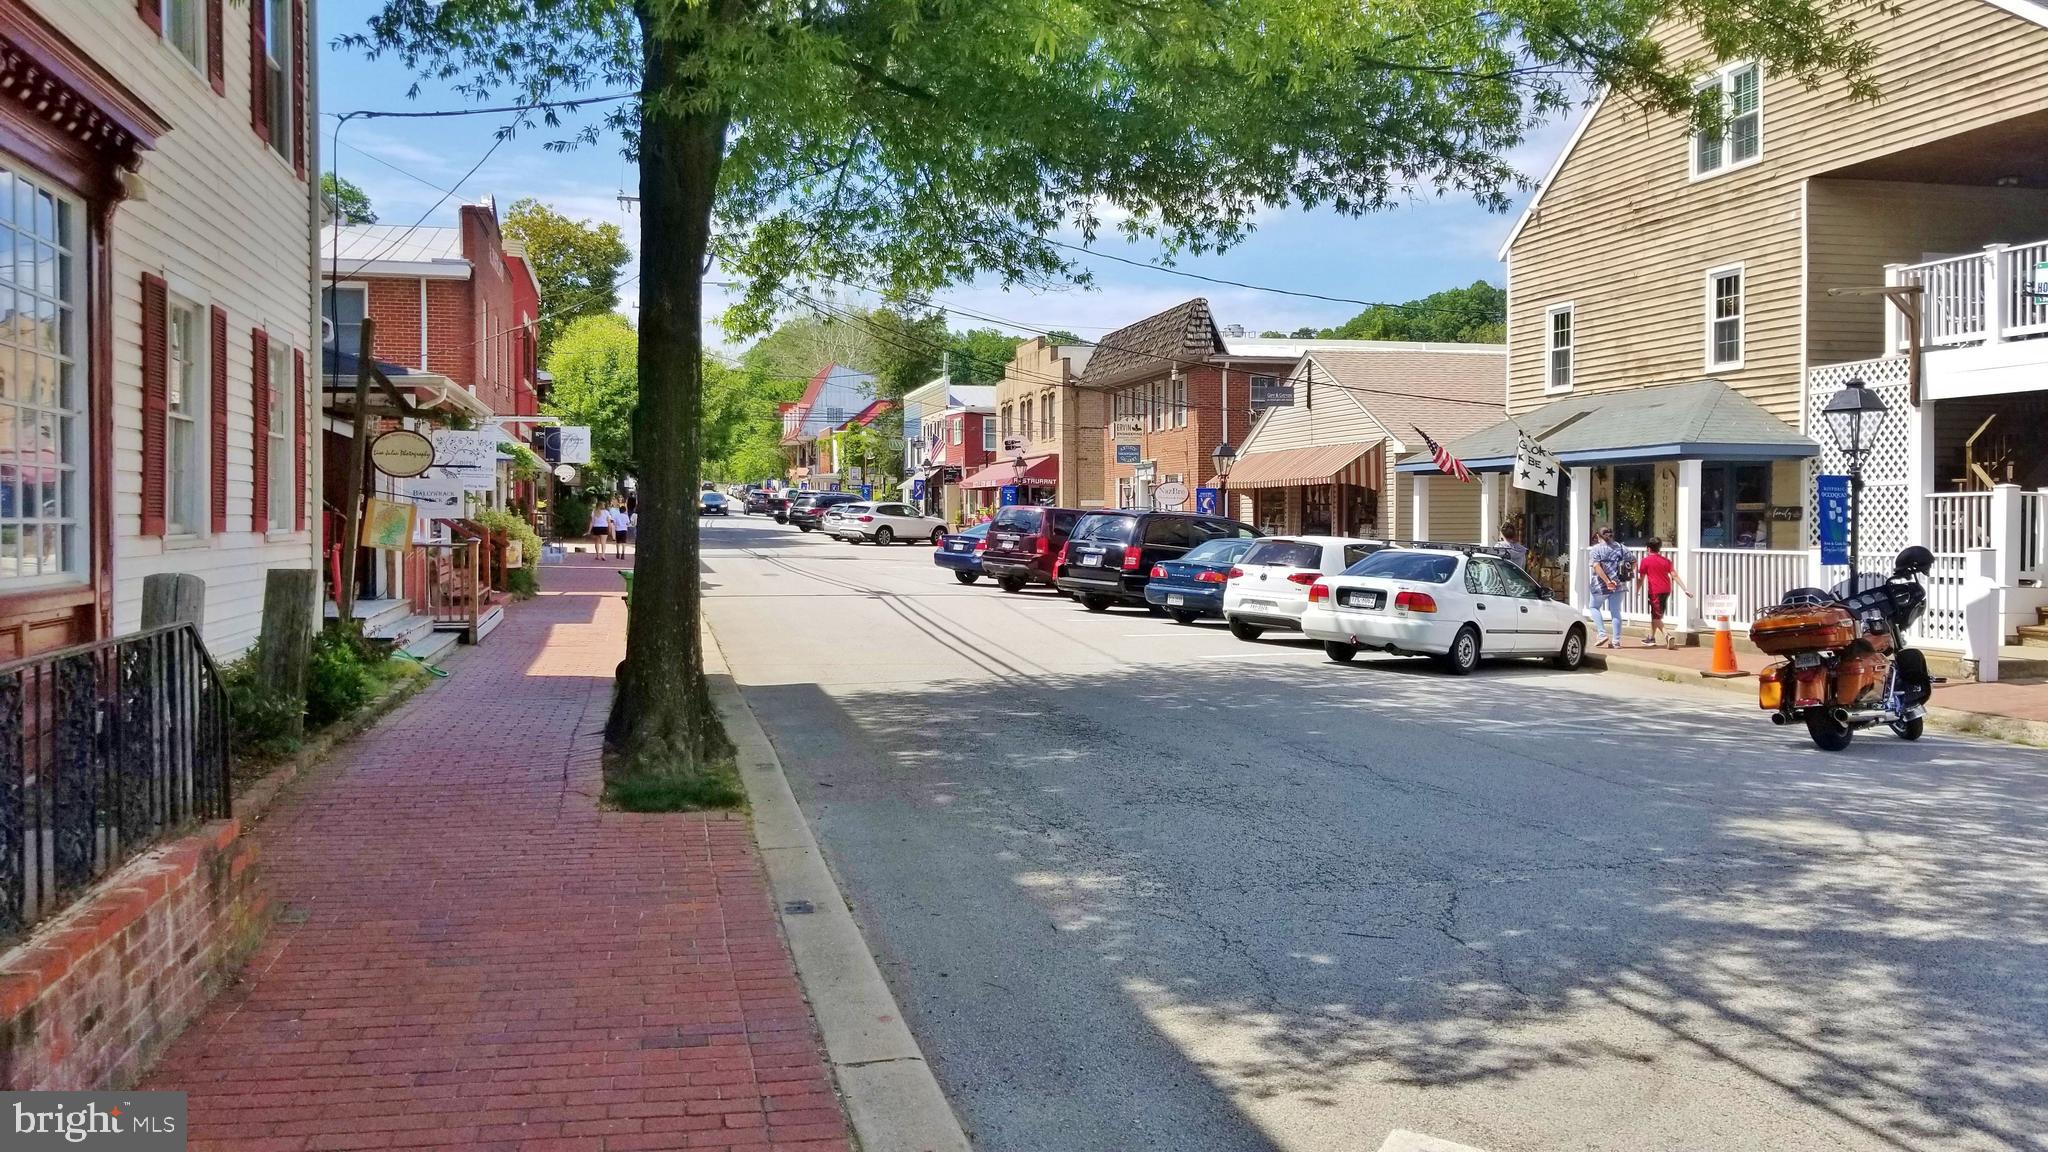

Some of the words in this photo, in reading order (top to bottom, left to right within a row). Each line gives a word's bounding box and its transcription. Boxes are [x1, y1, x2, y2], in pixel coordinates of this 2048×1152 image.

[1117, 423, 1131, 431] ERVIN
[400, 449, 431, 458] Photography
[1527, 456, 1542, 469] BE
